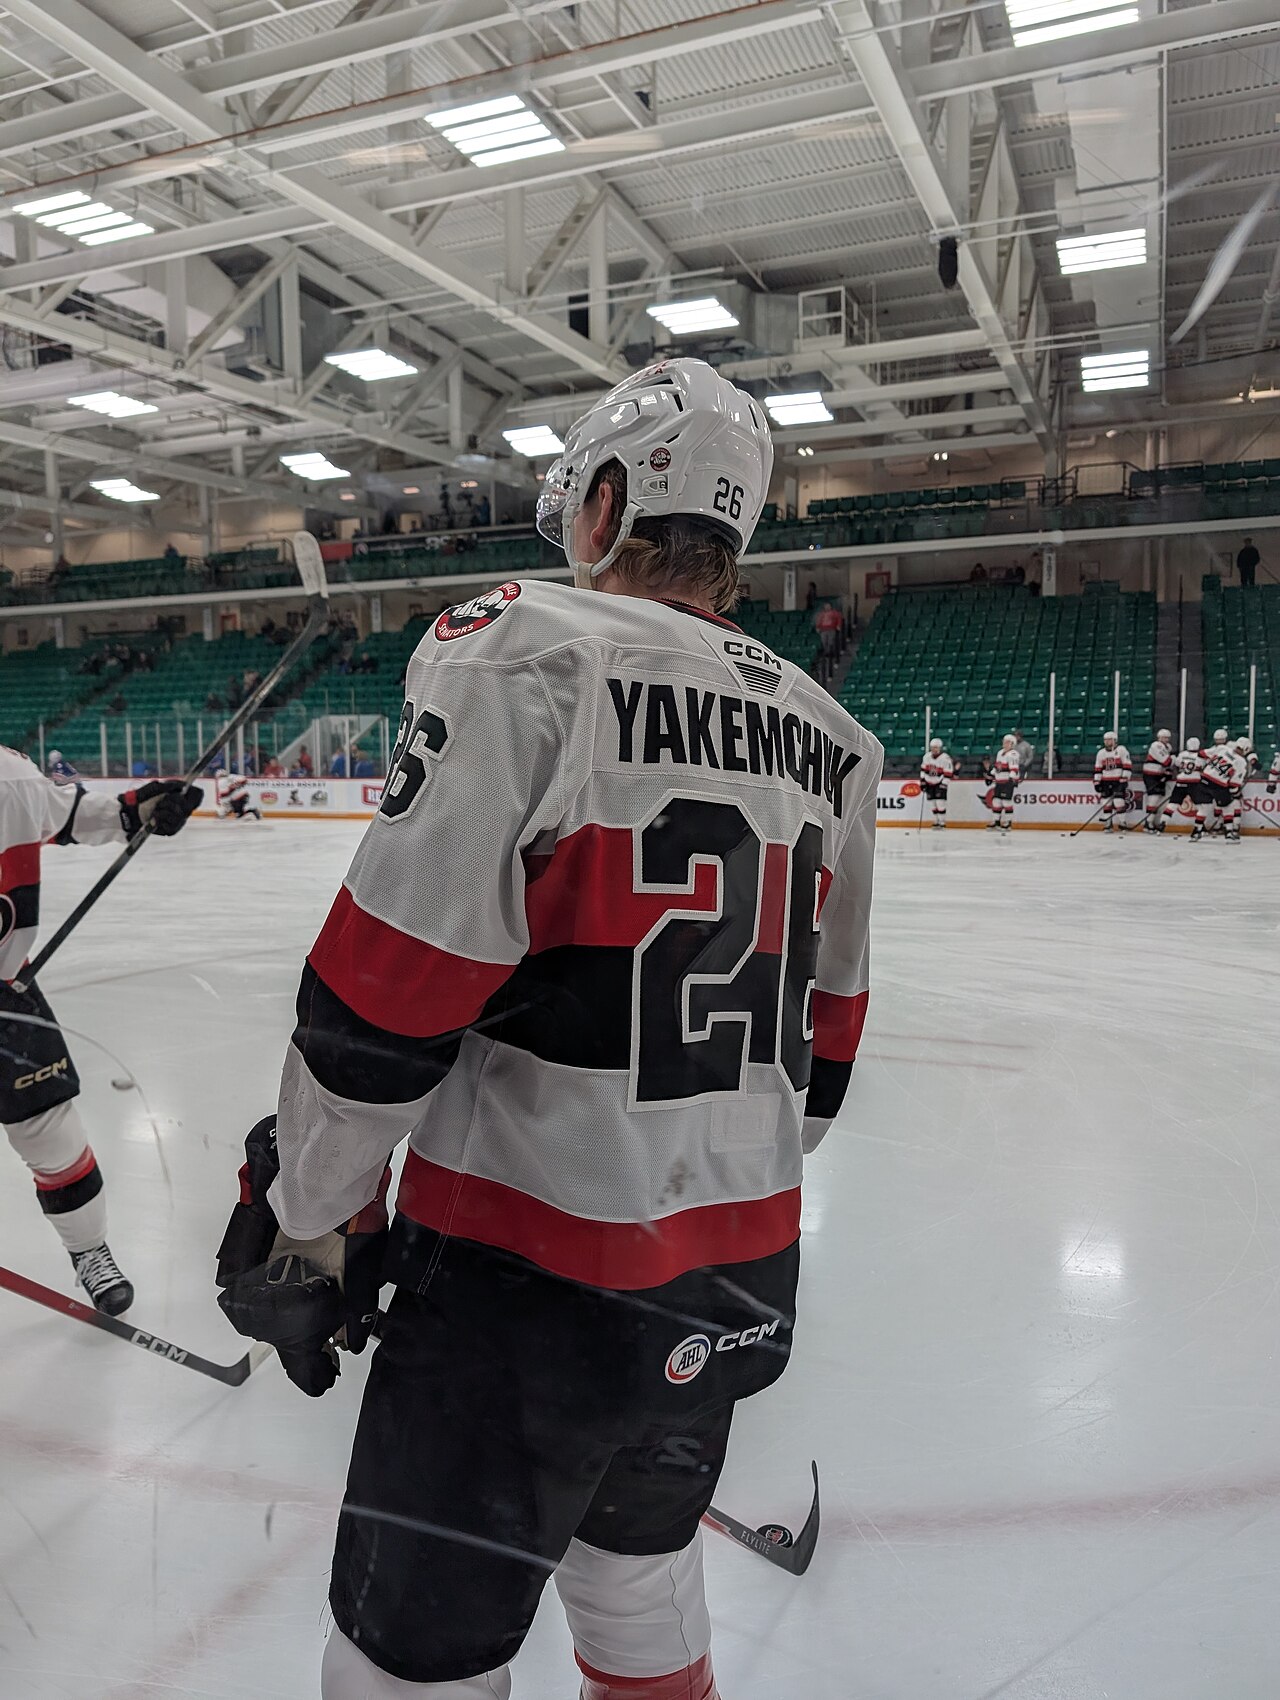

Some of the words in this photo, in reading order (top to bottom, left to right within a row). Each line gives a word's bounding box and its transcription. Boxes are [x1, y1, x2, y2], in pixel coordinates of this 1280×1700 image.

[713, 476, 744, 520] 26
[723, 640, 782, 671] CCM
[605, 678, 862, 820] YAKEMCHUK
[1014, 794, 1038, 805] 613
[1038, 794, 1103, 805] COUNTRY
[1243, 796, 1280, 812] sto
[13, 1057, 68, 1090] CCM
[131, 1330, 188, 1365] CCM
[715, 1319, 780, 1353] CCM
[675, 1344, 704, 1373] AHL
[740, 1530, 771, 1555] FLYLITE
